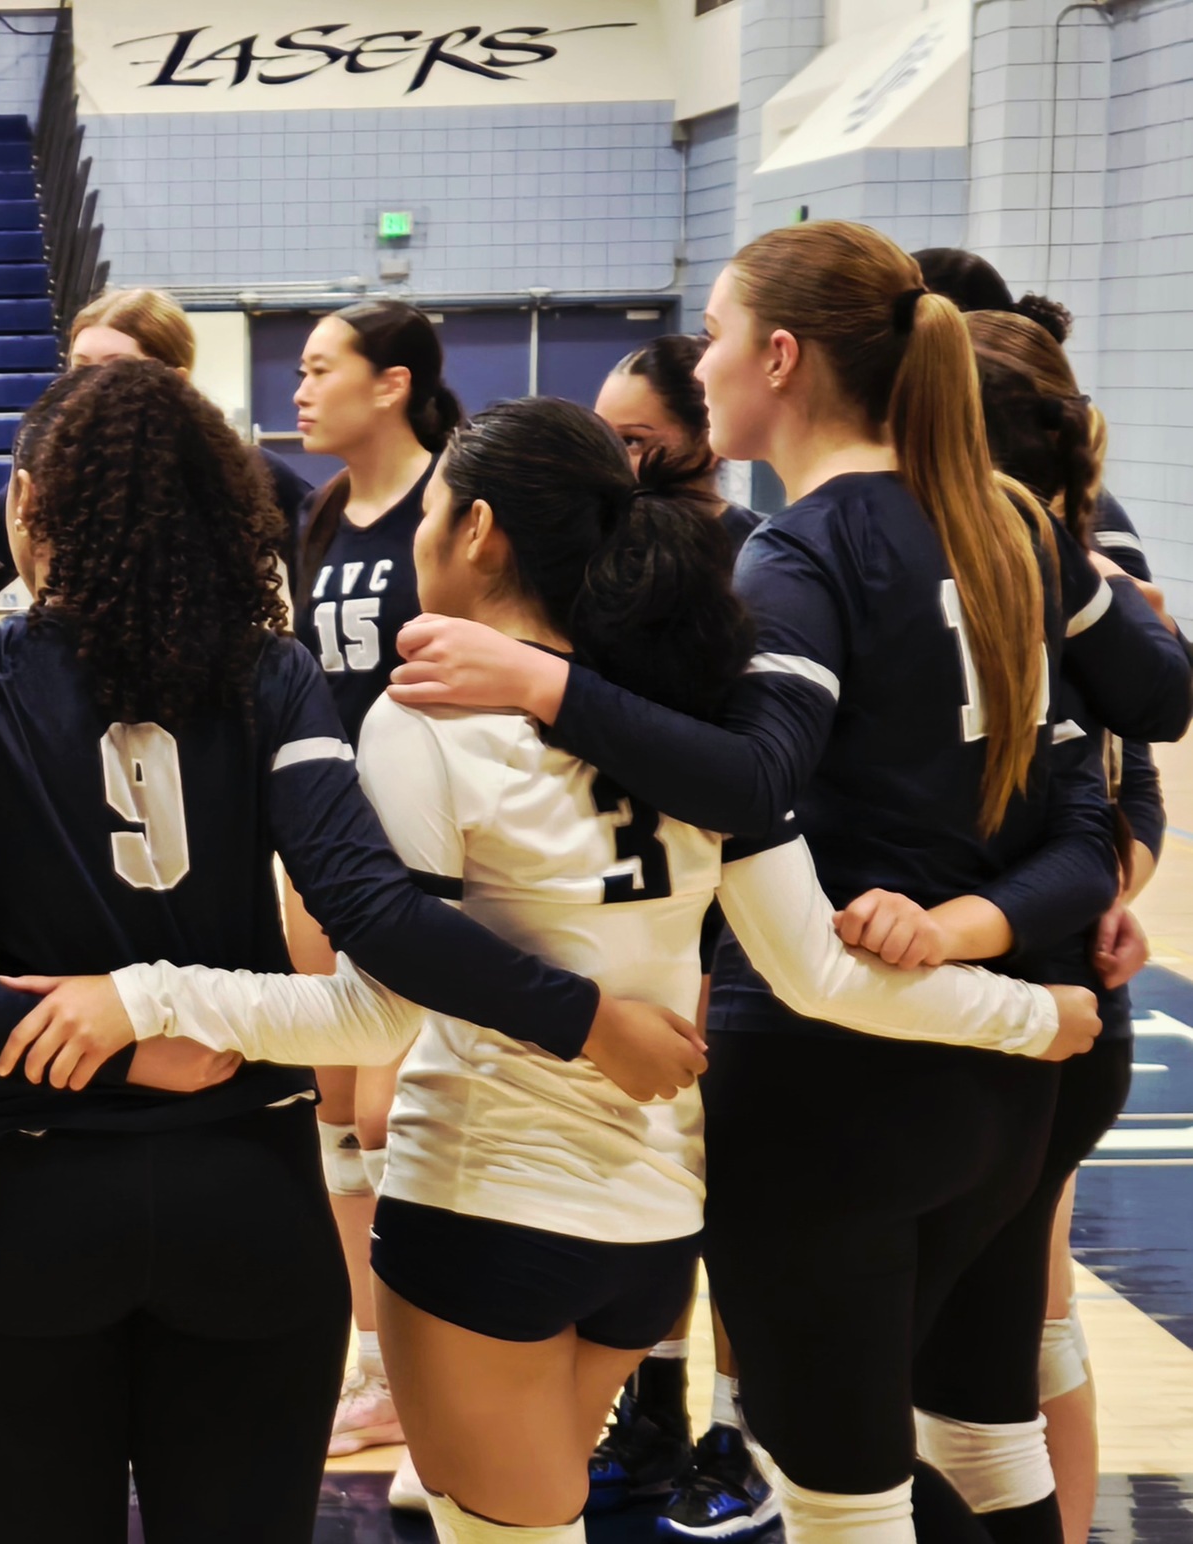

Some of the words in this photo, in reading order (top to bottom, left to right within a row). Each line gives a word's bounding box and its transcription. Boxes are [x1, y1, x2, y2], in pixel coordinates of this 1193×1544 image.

[111, 21, 638, 96] LASERS
[312, 558, 394, 598] IVC
[314, 597, 381, 672] 15
[100, 721, 190, 891] 9
